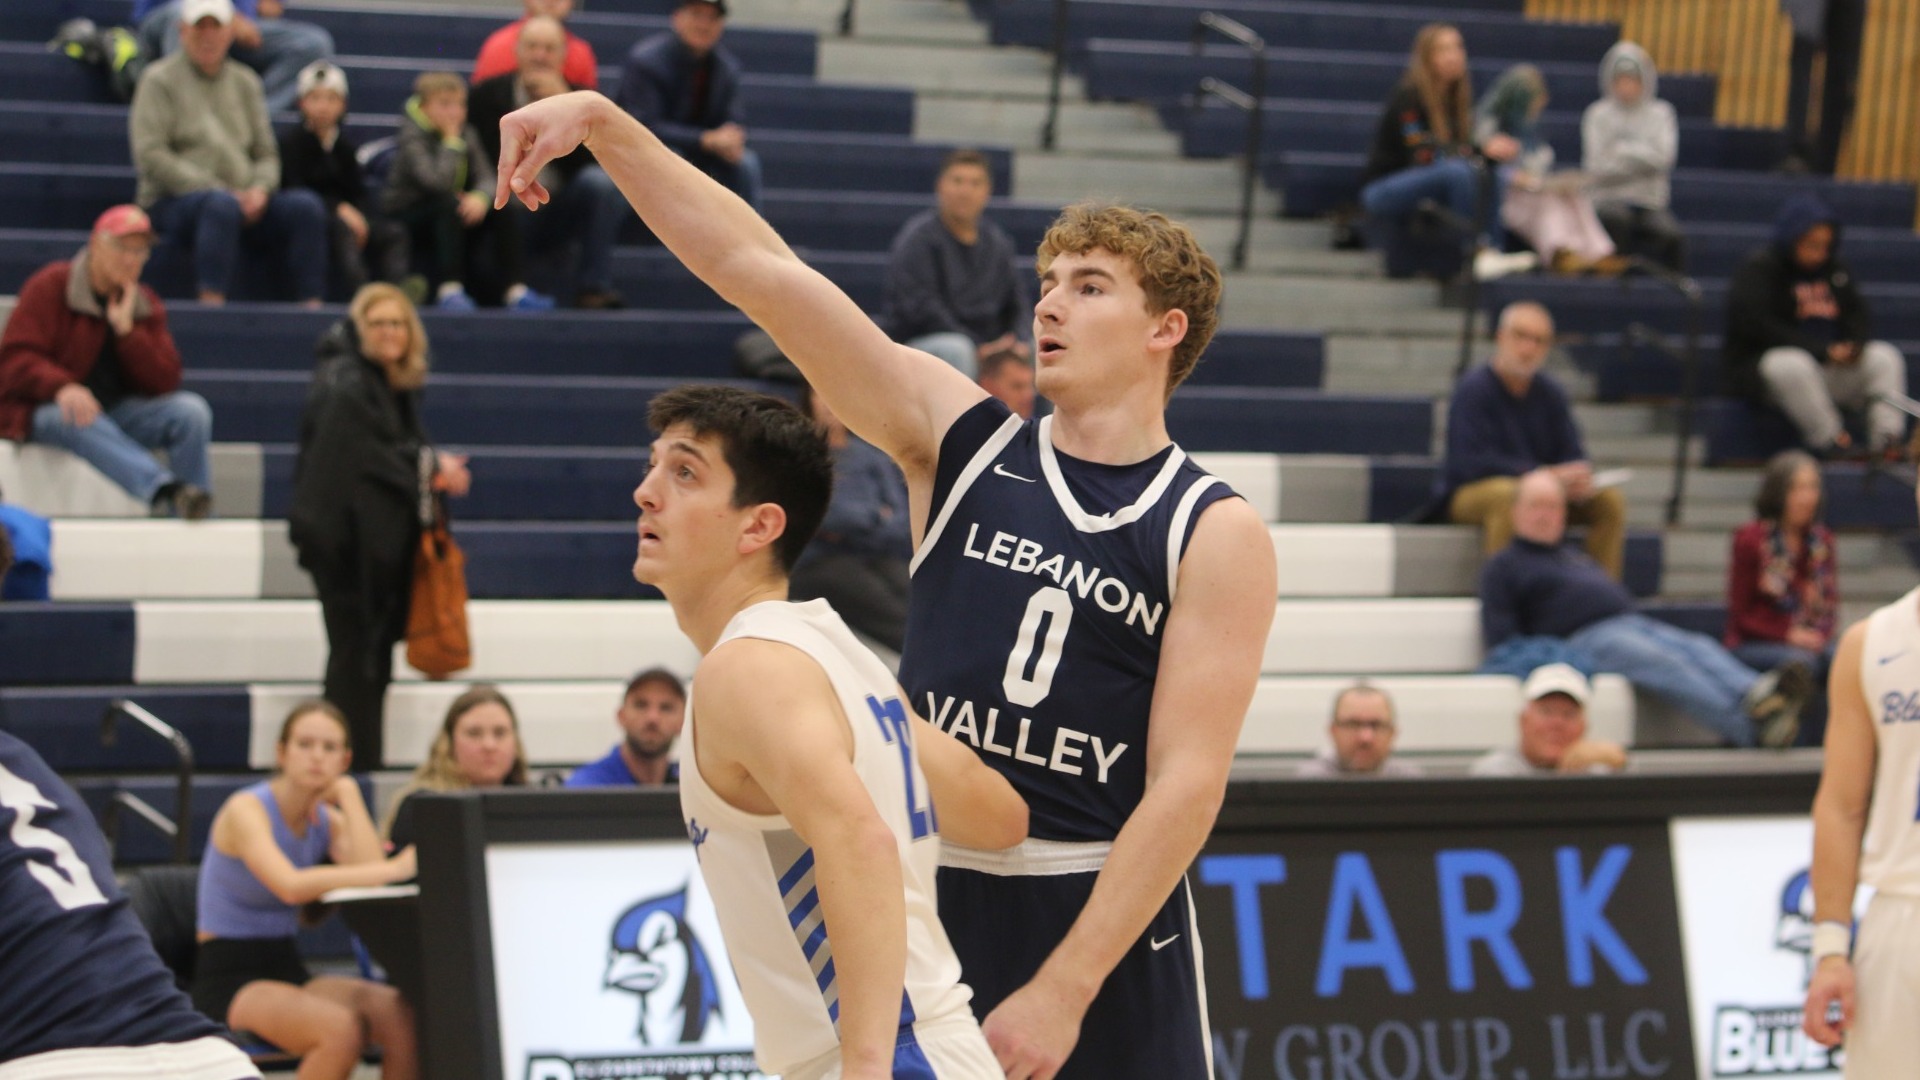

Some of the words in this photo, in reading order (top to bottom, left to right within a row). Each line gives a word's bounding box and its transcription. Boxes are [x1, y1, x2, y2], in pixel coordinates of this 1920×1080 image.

[963, 522, 1164, 635] LEBANON
[1002, 586, 1074, 708] 0
[926, 691, 1128, 783] VALLEY
[1548, 1008, 1671, 1080] LLC
